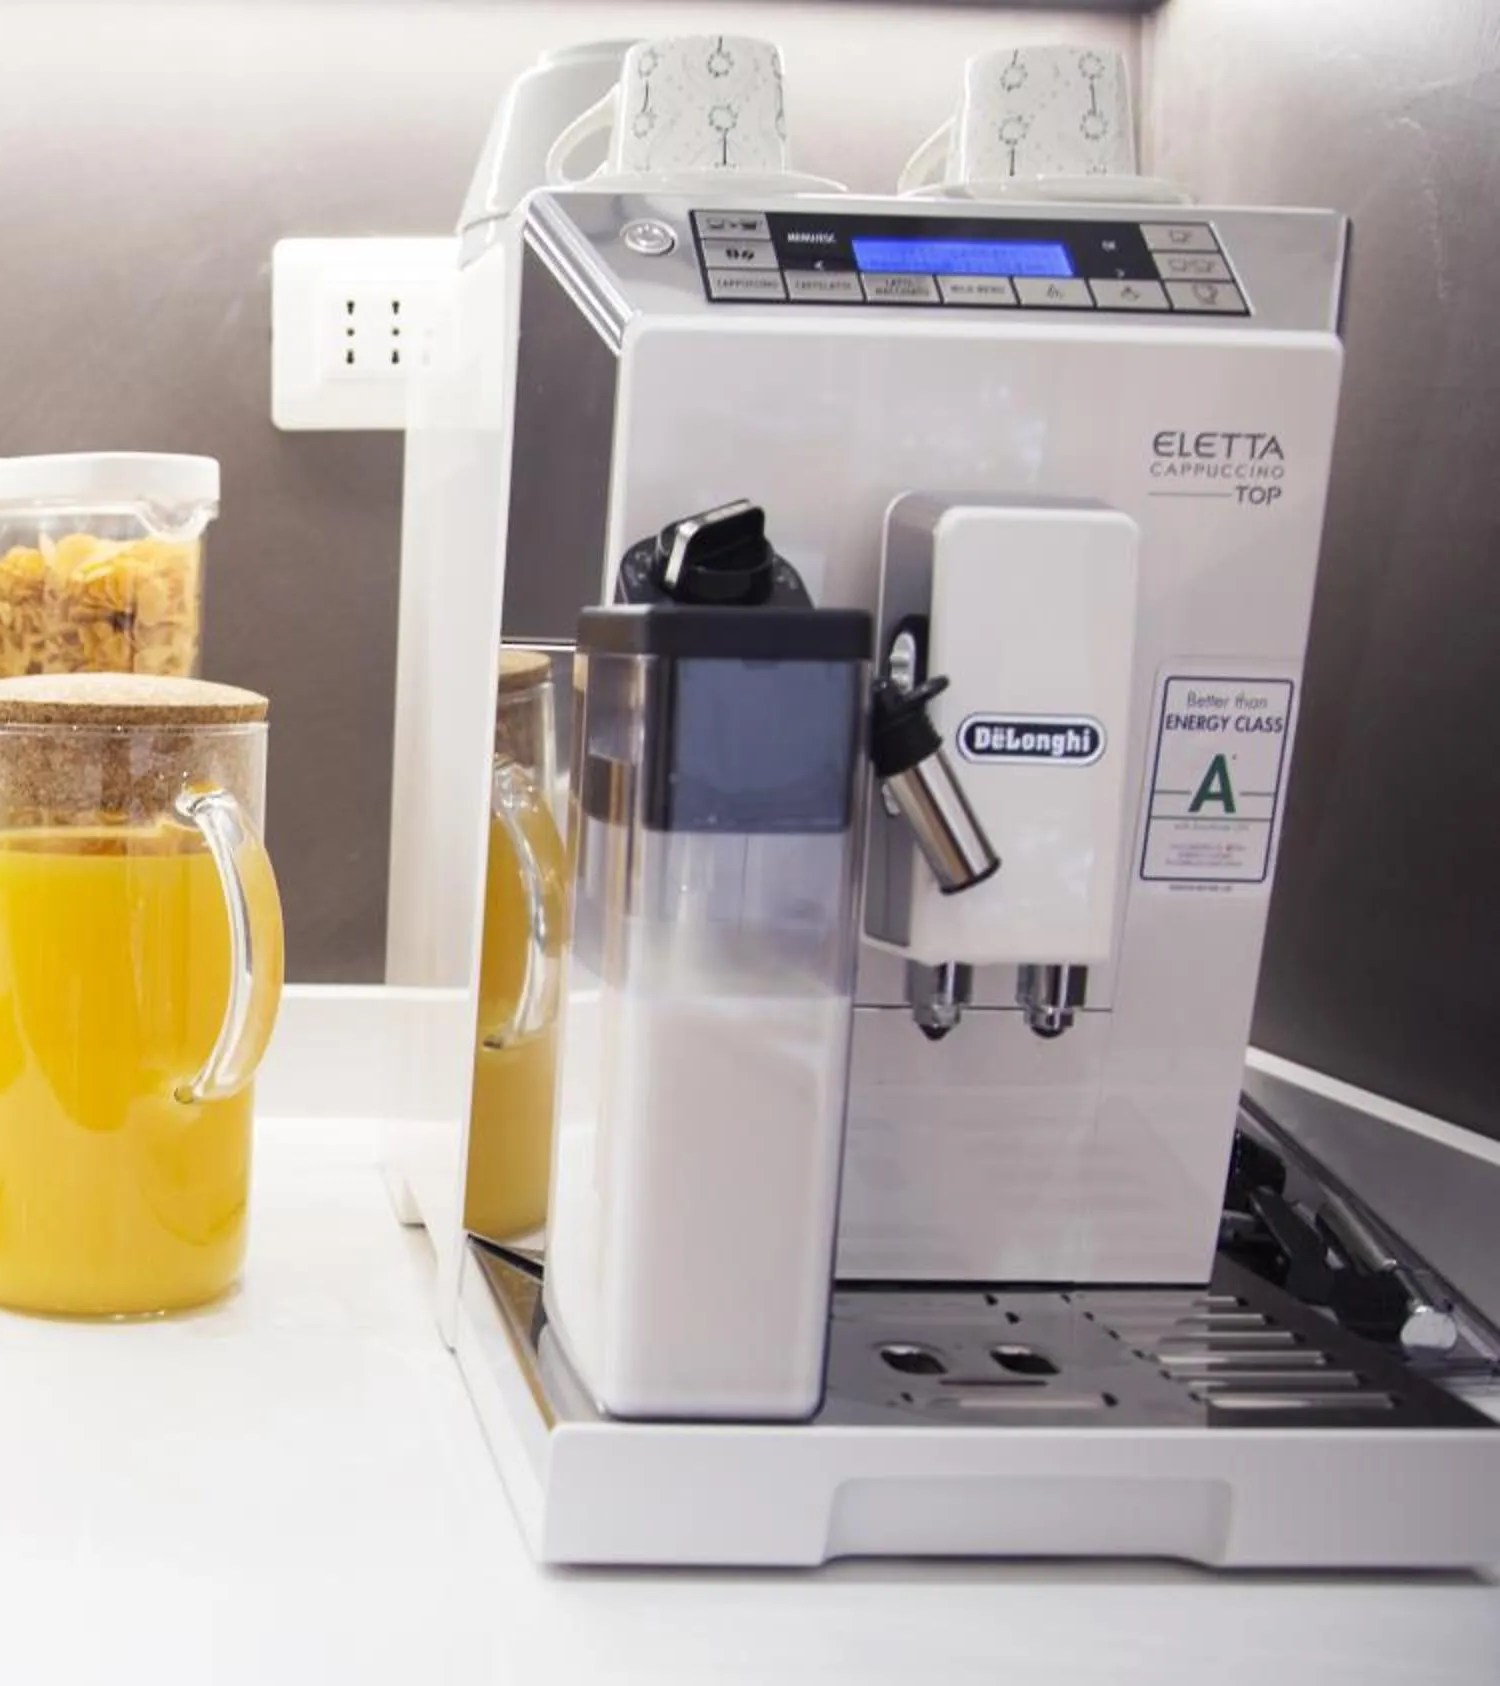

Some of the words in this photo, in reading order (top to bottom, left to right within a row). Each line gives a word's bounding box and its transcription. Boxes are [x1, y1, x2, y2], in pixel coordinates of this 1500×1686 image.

[1152, 431, 1285, 460] ELETTA
[1149, 461, 1285, 480] CAPPUCCINO
[1235, 485, 1282, 505] TOP
[1187, 690, 1230, 708] Better
[1235, 691, 1267, 709] than
[1165, 713, 1231, 732] ENERGY
[1235, 714, 1283, 733] CLASS
